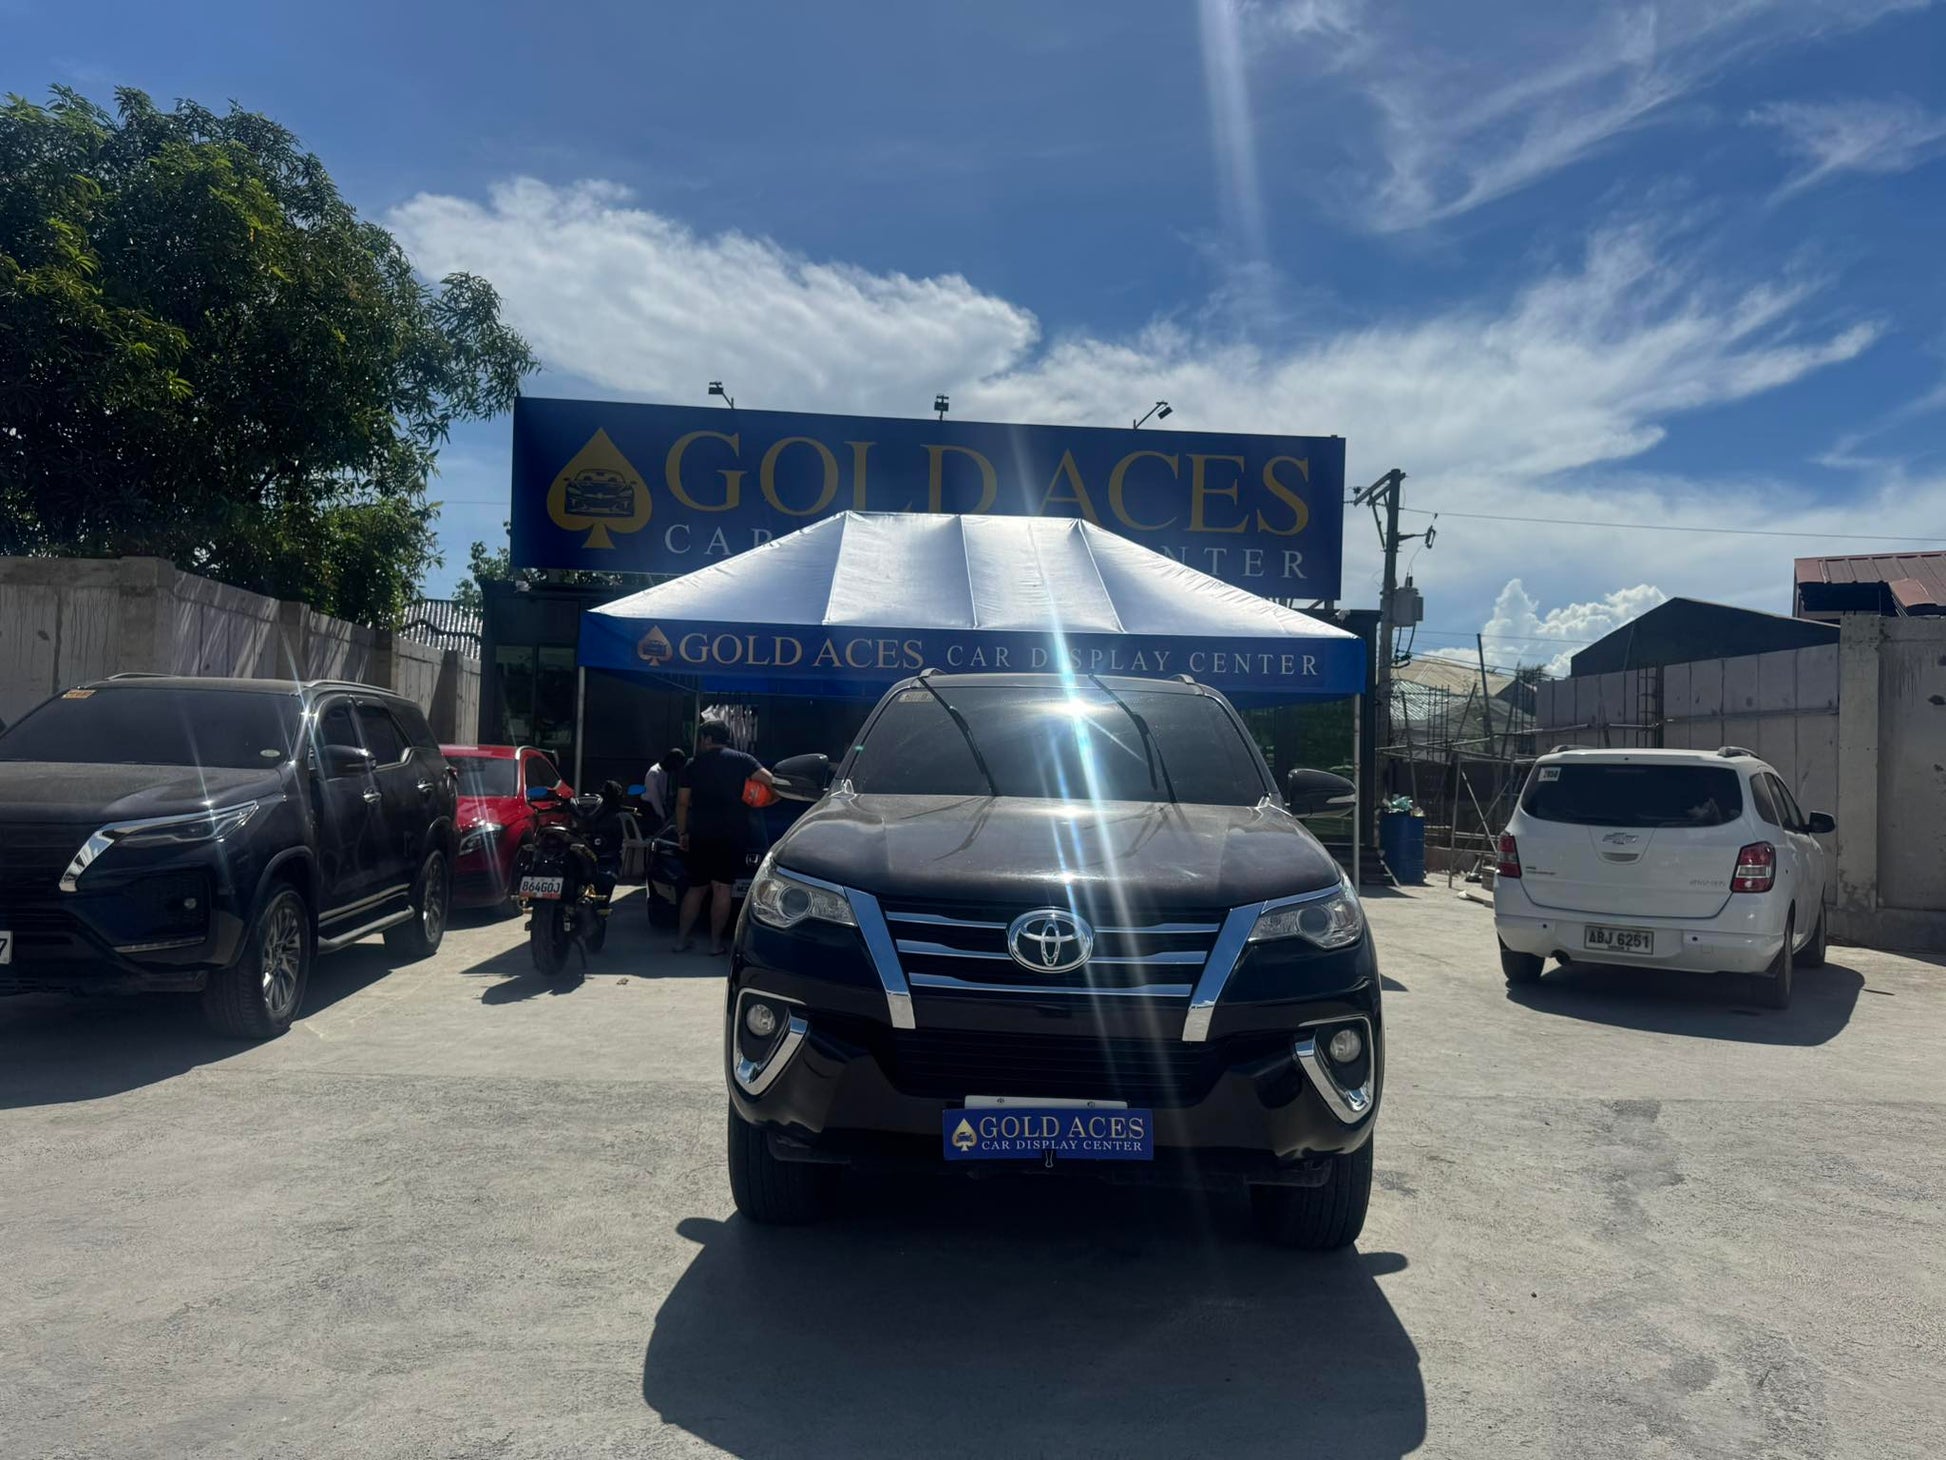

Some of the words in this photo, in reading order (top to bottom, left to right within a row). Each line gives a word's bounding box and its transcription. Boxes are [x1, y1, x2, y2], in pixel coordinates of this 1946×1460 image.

[665, 430, 998, 516] GOLD
[1039, 448, 1310, 537] ACES
[679, 632, 802, 667] GOLD
[812, 637, 924, 670] ACES
[947, 645, 1012, 668] CAR
[1031, 647, 1171, 673] DSPLAY
[1189, 652, 1320, 677] CENTER
[1588, 930, 1613, 944] ABJ
[1617, 932, 1649, 948] 6251
[980, 1116, 1060, 1138] GOLD
[1068, 1117, 1144, 1139] ACES
[982, 1141, 1010, 1150] CAR
[1017, 1140, 1078, 1151] DISPLAY
[1083, 1141, 1142, 1151] CENTER
